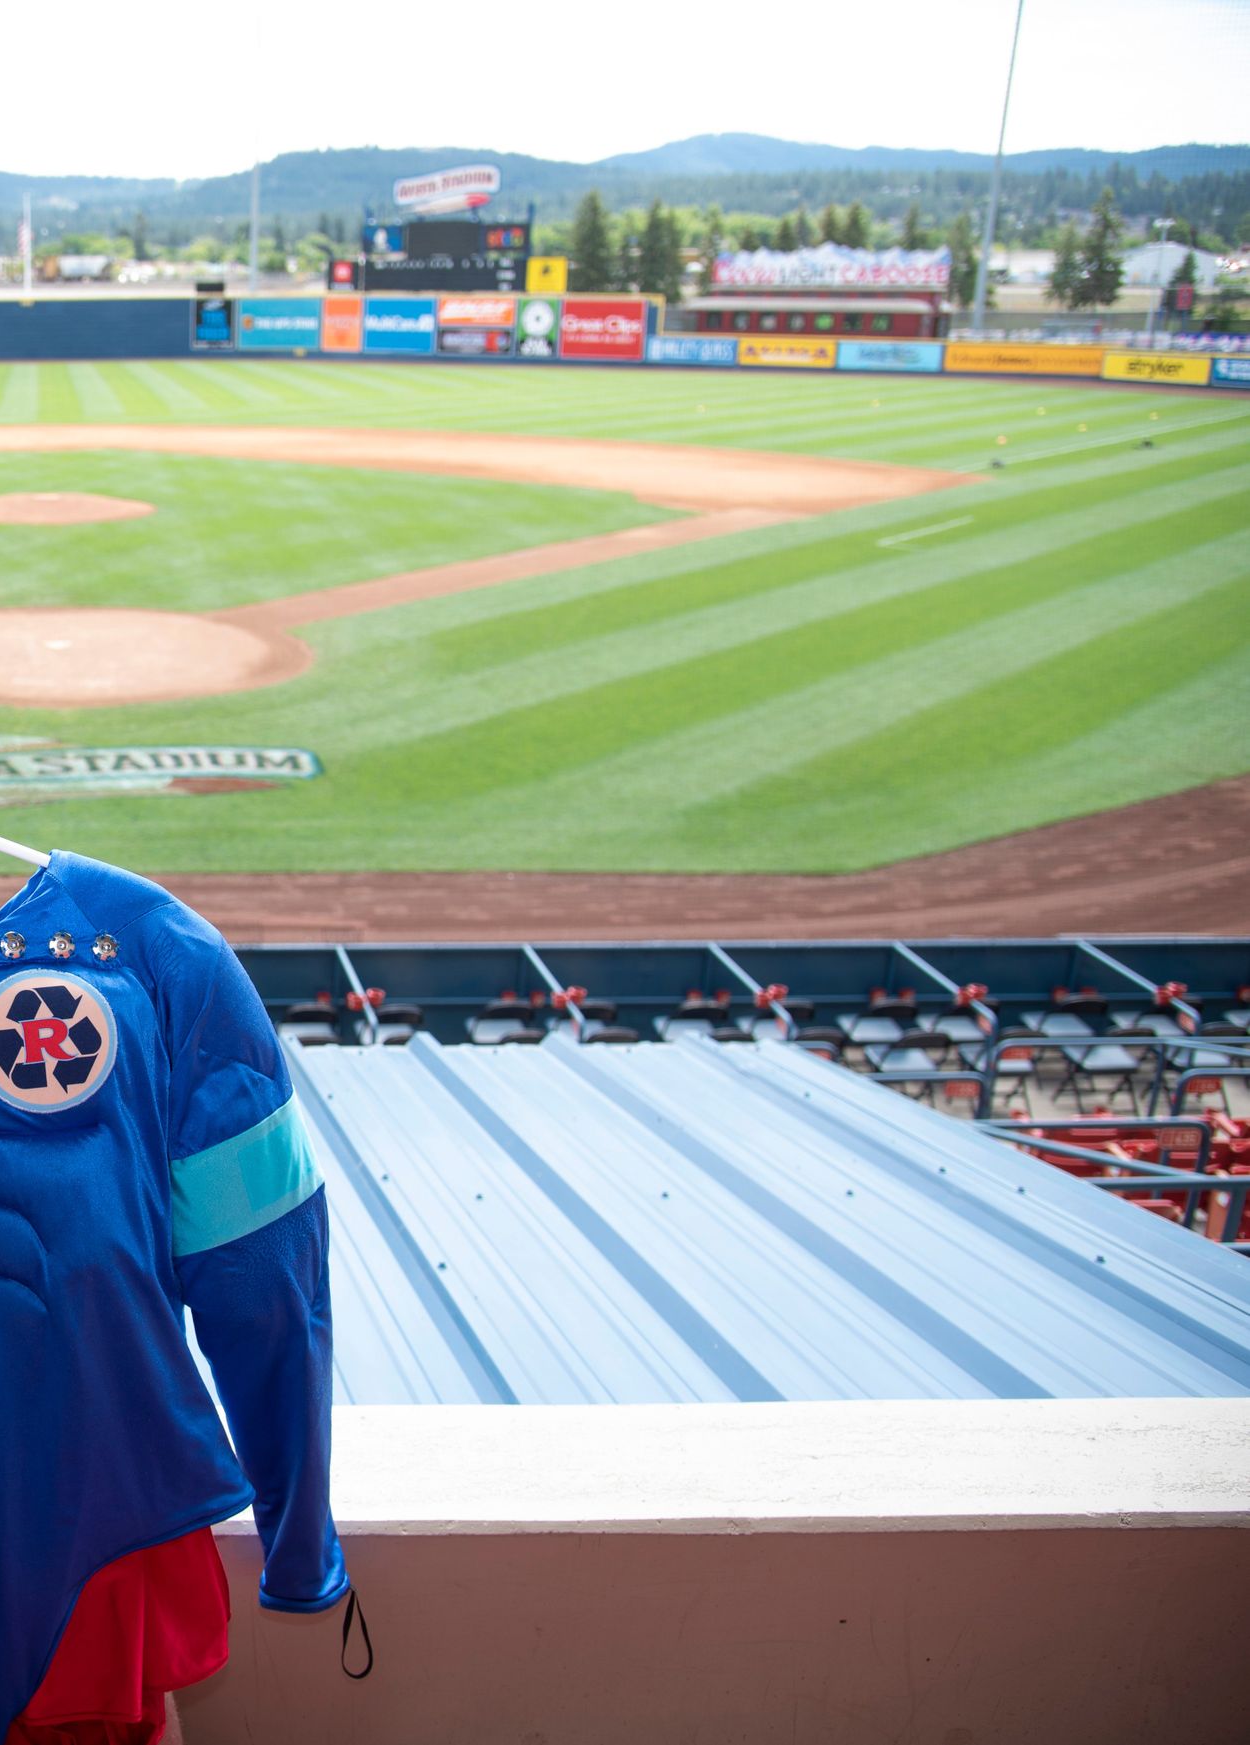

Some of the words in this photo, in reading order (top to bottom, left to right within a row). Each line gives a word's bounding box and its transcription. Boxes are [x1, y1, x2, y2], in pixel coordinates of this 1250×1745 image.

[840, 263, 949, 284] CABOOSE
[561, 315, 603, 332] Great
[604, 315, 642, 334] Clips
[1126, 357, 1184, 377] stryker
[32, 751, 305, 775] STADIUM
[18, 1017, 78, 1065] R
